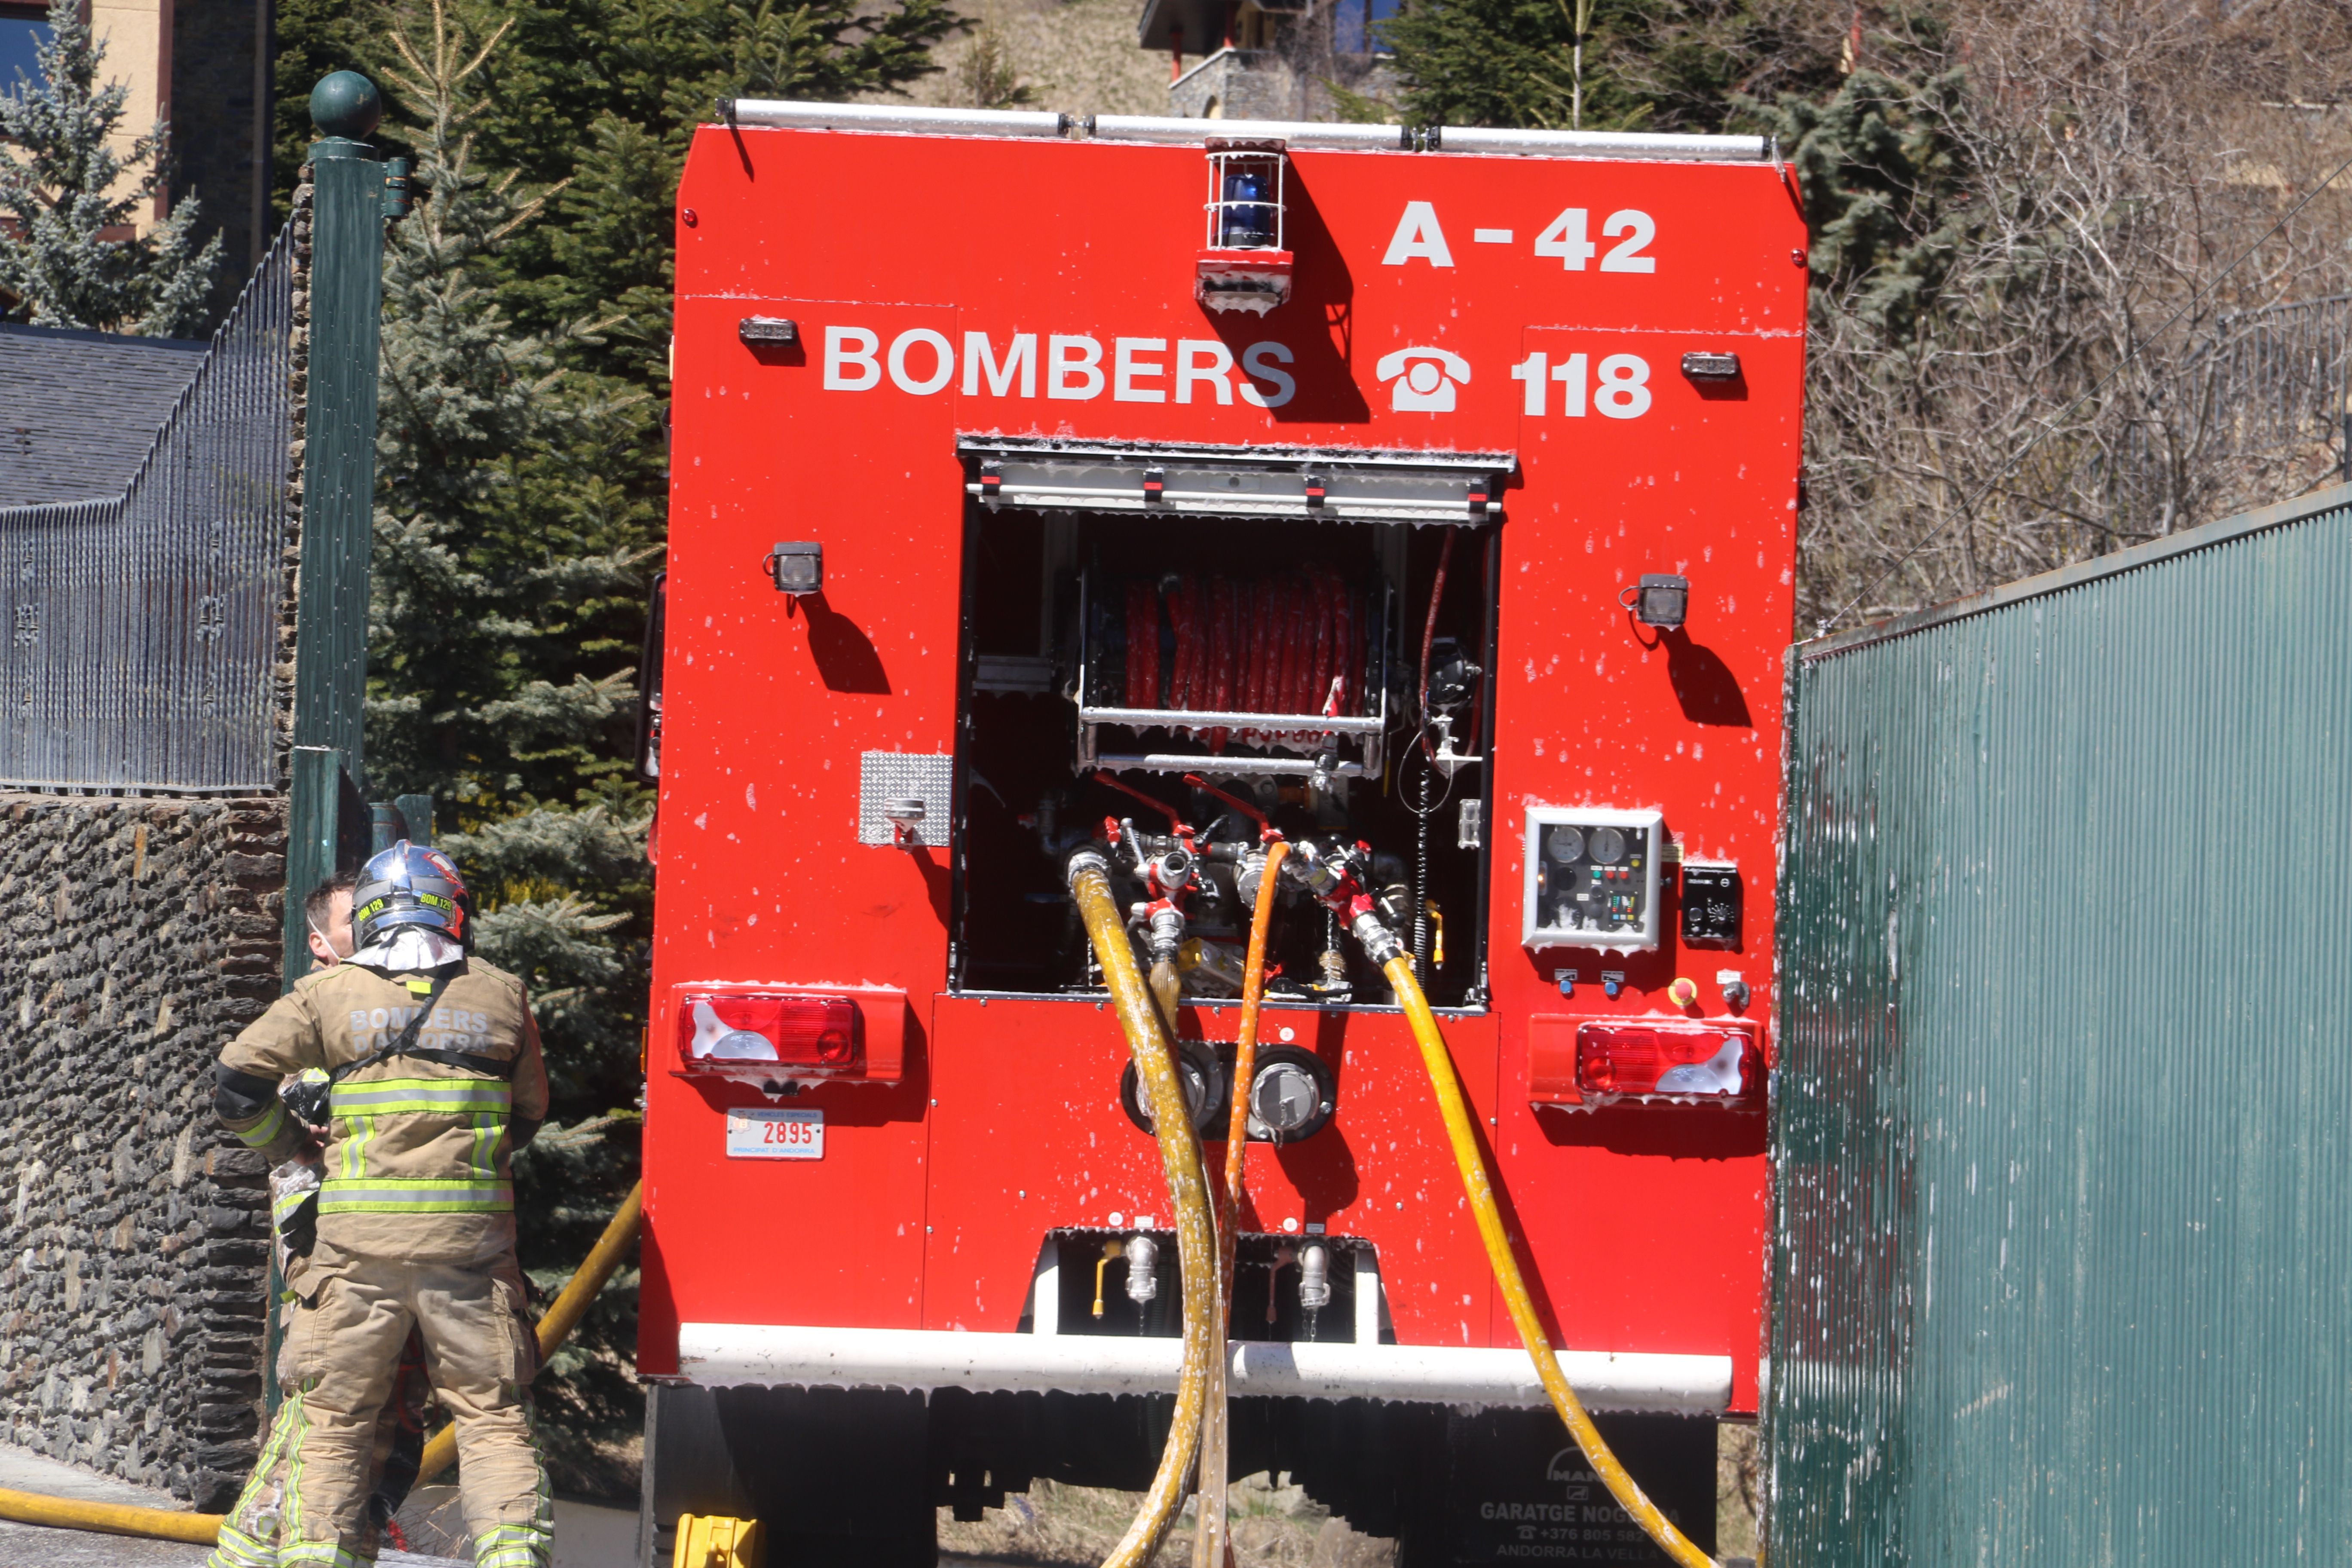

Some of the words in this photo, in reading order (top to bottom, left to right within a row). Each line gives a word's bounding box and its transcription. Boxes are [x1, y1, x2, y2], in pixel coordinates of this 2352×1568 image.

[1534, 208, 1656, 273] 42
[822, 324, 1295, 408] BOMBERS
[1511, 352, 1652, 419] 118
[358, 906, 371, 922] BOM
[370, 898, 384, 912] 129
[420, 892, 438, 906] BOM
[440, 898, 452, 911] 129
[764, 1121, 812, 1144] 2895
[1480, 1501, 1576, 1522] GARATGE
[1540, 1527, 1578, 1540] +376
[1583, 1528, 1611, 1541] 805
[1616, 1530, 1645, 1542] 582
[1496, 1544, 1578, 1558] ANDORRA
[1582, 1547, 1603, 1559] LA
[1607, 1548, 1659, 1561] VELLA
